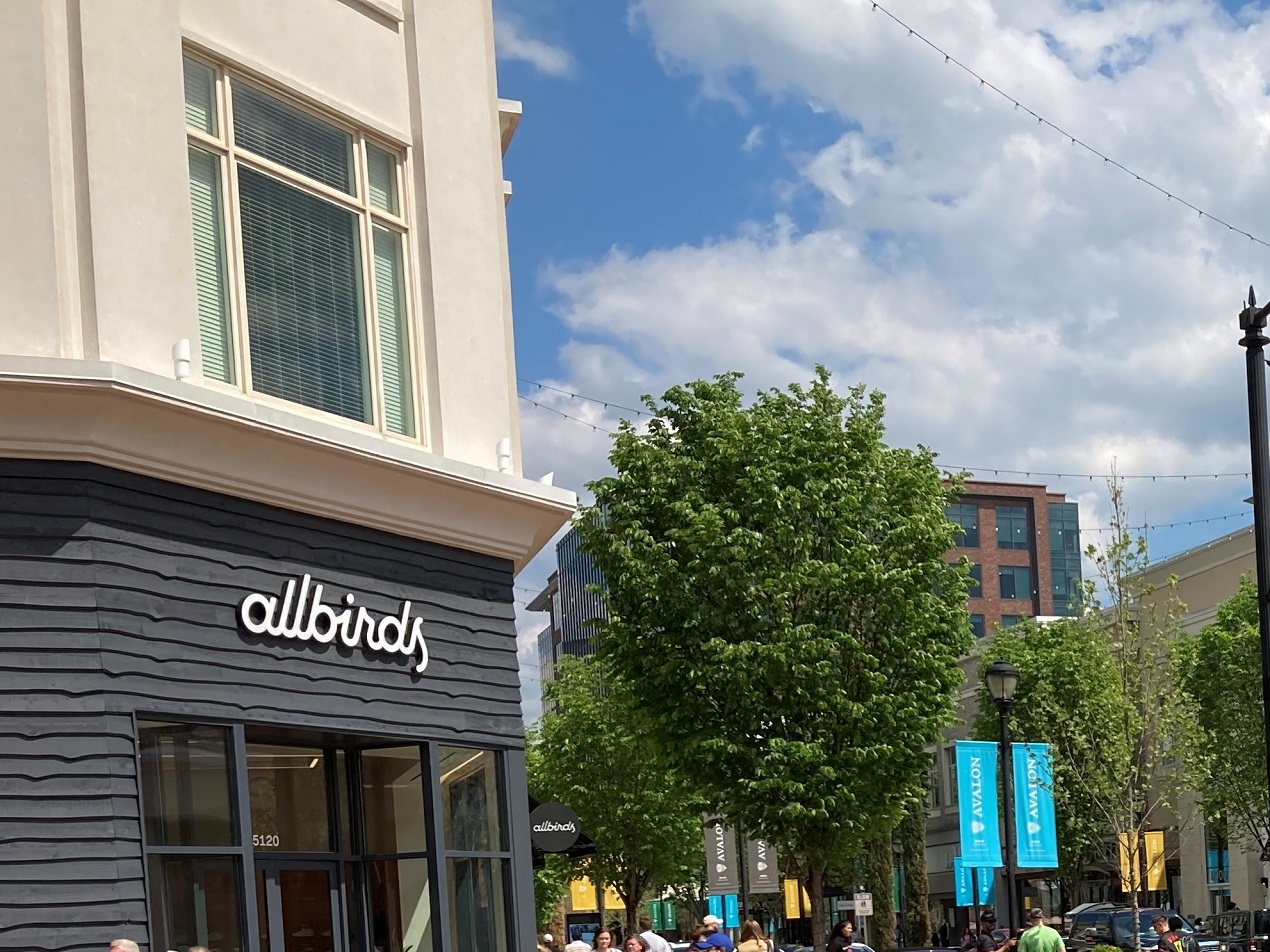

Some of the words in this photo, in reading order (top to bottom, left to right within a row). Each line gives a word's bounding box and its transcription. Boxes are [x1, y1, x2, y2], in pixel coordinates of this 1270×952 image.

[241, 573, 429, 673] allbirds
[970, 756, 983, 818] AVALON
[252, 834, 280, 847] 5120
[533, 820, 576, 833] allbirds
